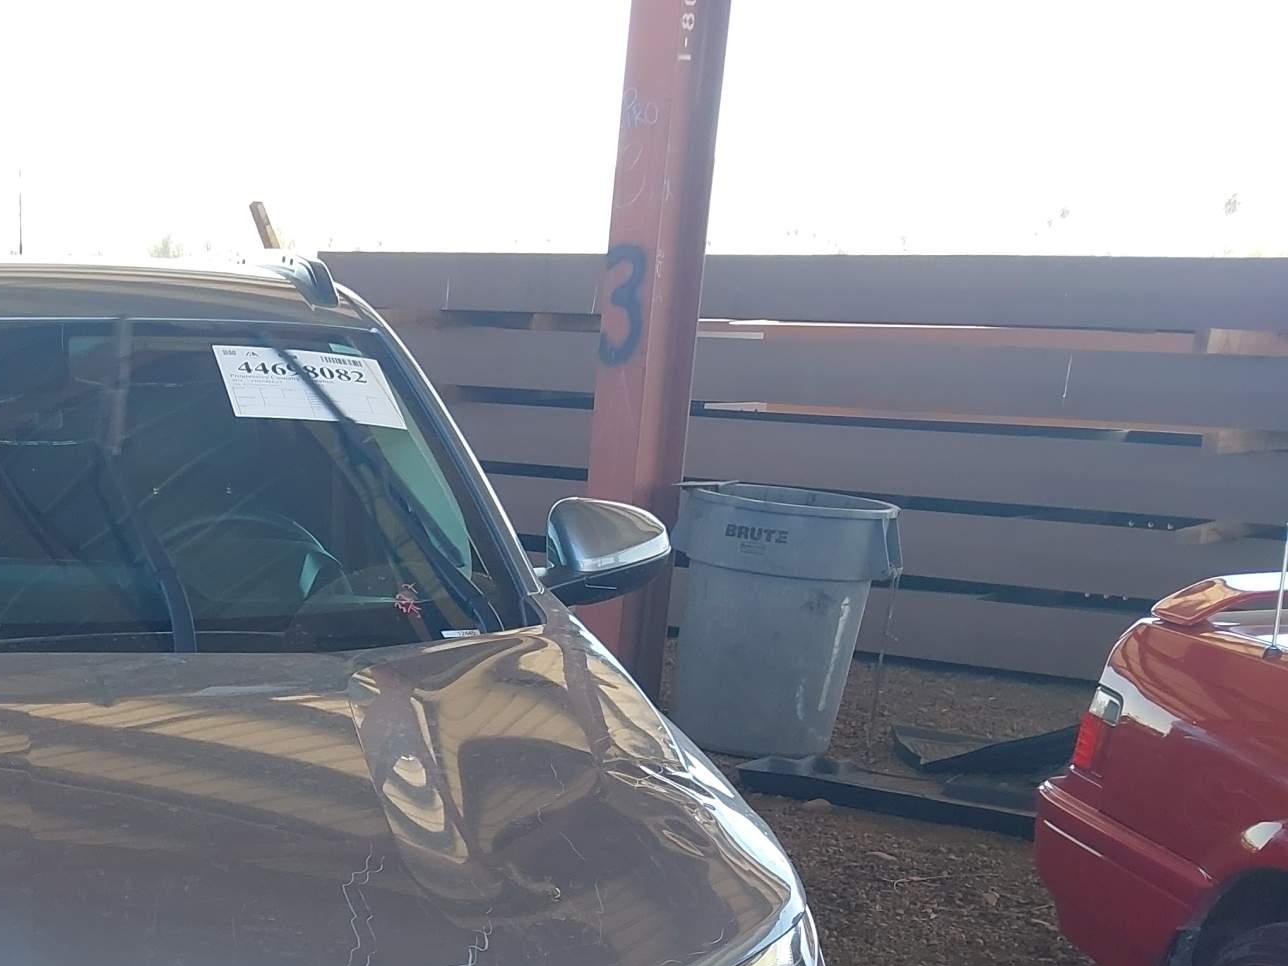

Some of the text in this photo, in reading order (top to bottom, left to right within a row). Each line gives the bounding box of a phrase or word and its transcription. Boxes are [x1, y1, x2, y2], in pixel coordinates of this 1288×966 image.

[599, 243, 648, 367] 3
[238, 361, 368, 384] 44698082
[725, 524, 789, 544] BRUTE
